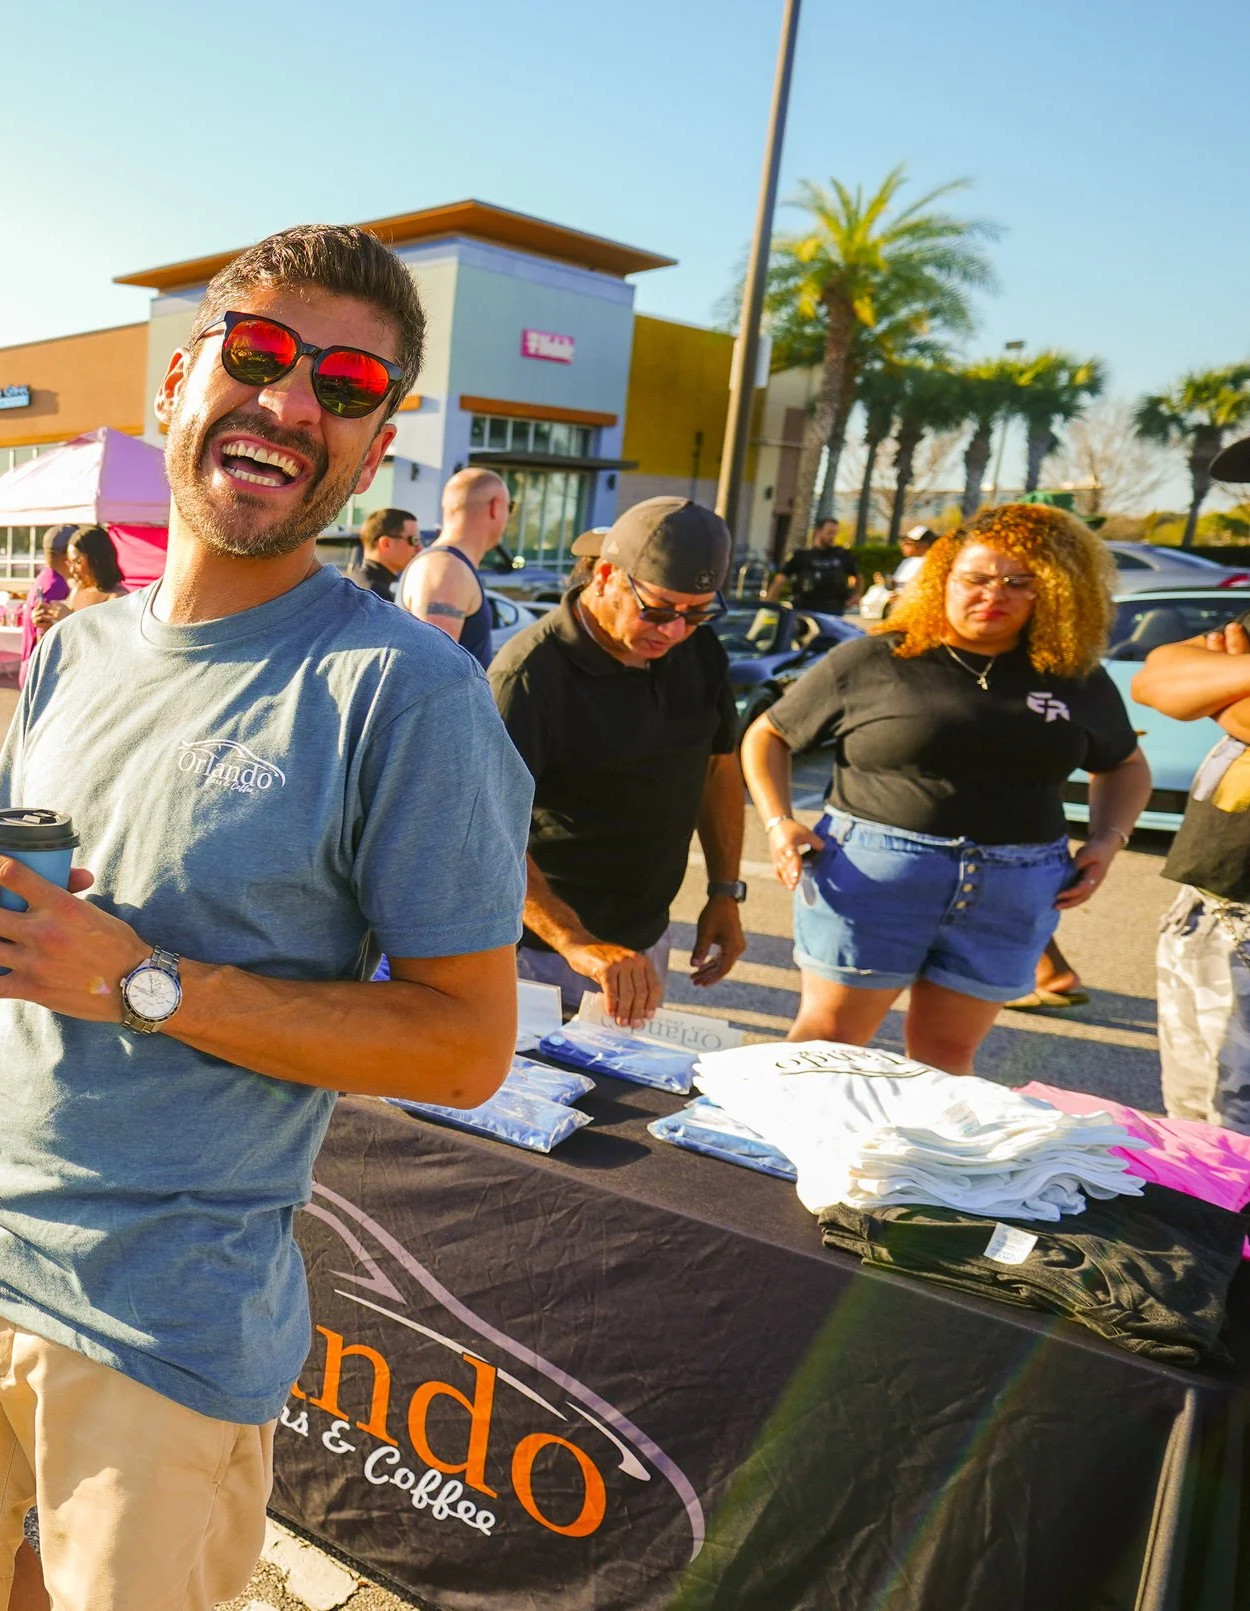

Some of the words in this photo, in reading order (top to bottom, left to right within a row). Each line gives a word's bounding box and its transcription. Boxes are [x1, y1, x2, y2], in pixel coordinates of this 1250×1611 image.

[178, 750, 273, 790] Orlando
[616, 1019, 722, 1050] Orland
[291, 1324, 607, 1538] ndo
[321, 1420, 357, 1454] &
[363, 1445, 497, 1537] Coffee
